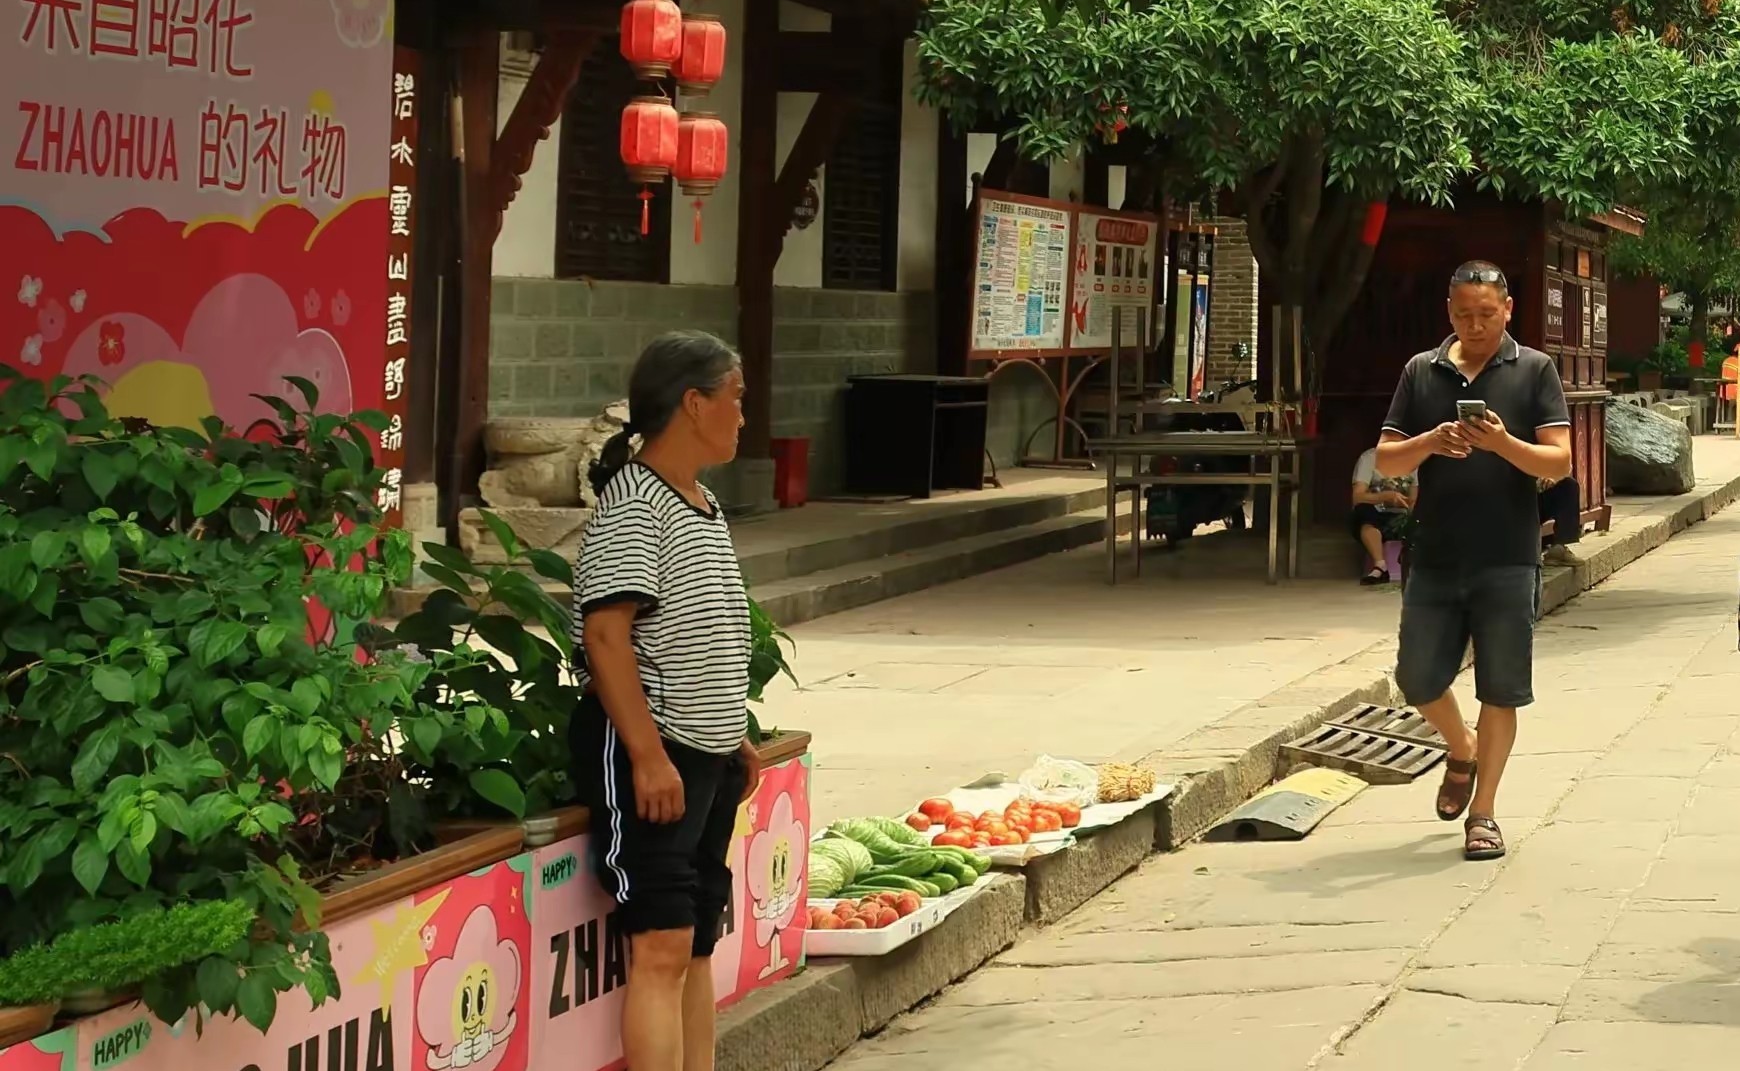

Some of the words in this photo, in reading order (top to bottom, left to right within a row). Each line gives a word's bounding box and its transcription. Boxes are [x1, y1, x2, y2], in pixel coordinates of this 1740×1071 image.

[14, 101, 179, 183] ZHAOHUA
[199, 100, 346, 200] 的礼物
[542, 856, 572, 885] HAPPY
[94, 1021, 143, 1066] HAPPY
